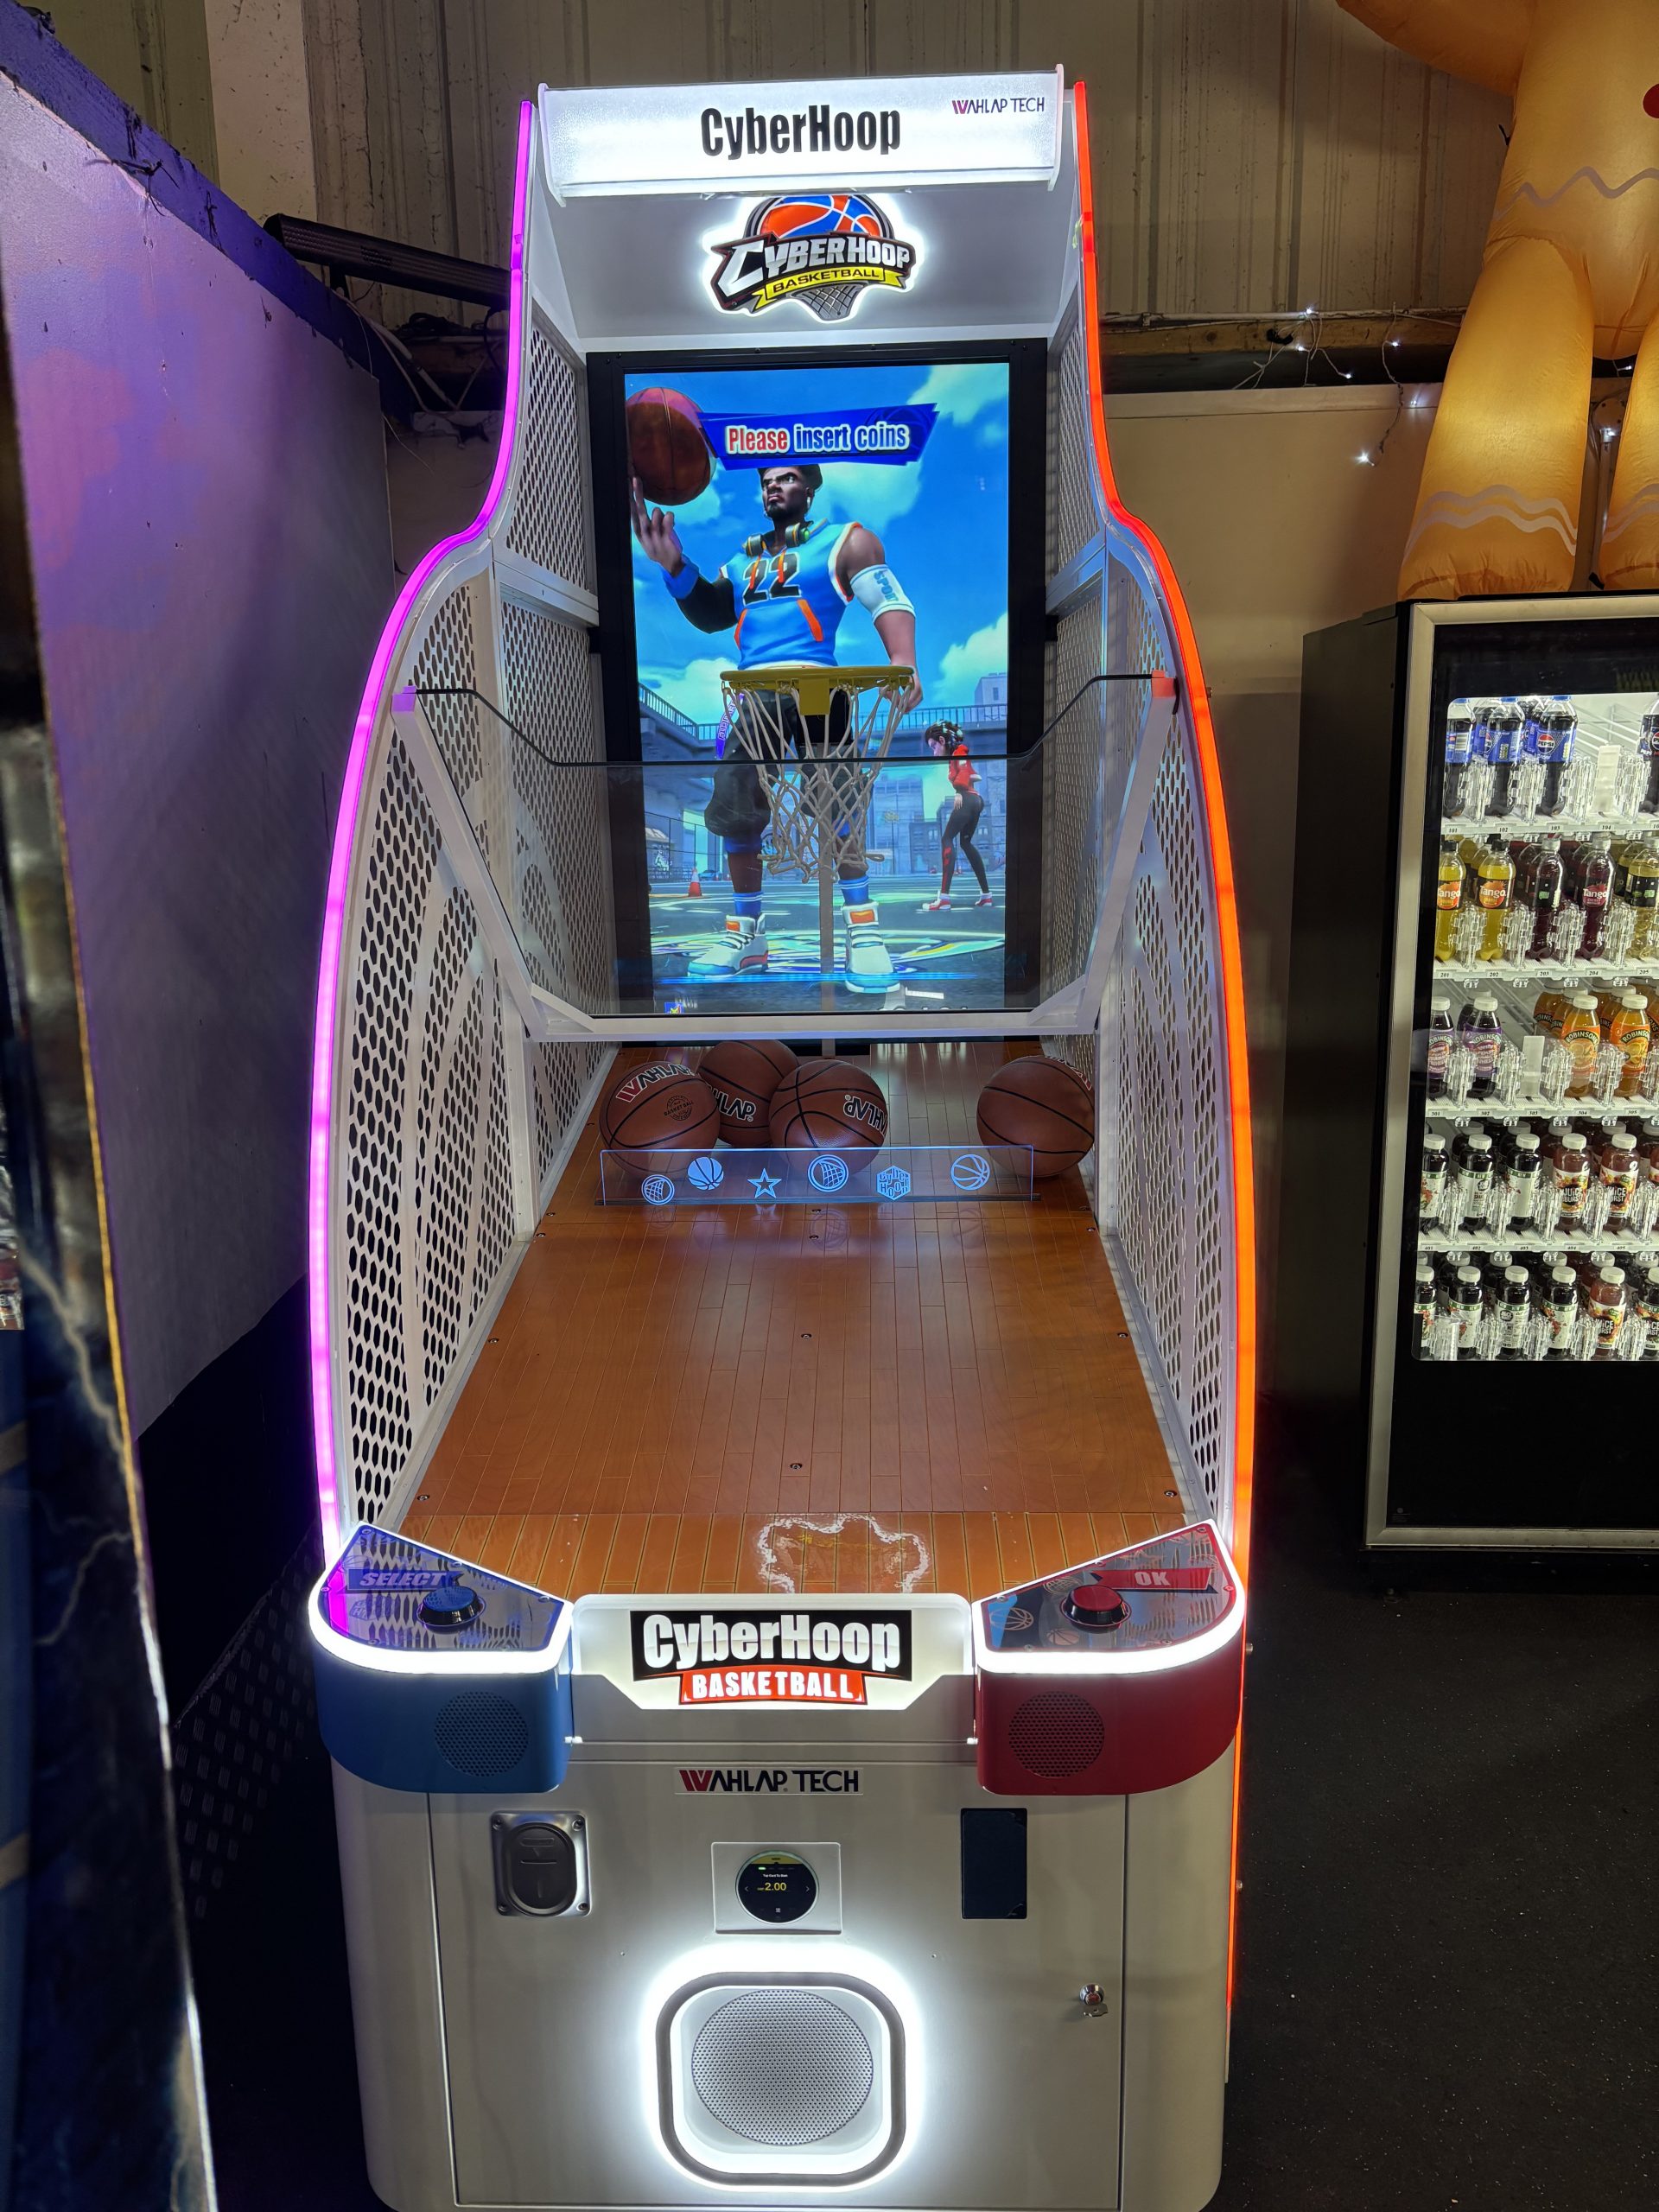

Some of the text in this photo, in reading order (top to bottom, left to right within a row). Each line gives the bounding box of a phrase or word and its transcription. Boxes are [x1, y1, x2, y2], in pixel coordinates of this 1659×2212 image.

[951, 97, 1045, 115] WAHLAP TECH
[701, 104, 900, 161] CyberHoop
[717, 235, 910, 297] CYBERHOOP
[772, 268, 880, 294] BASKETBALL
[728, 422, 908, 453] Please insert coins
[742, 551, 802, 607] 22
[712, 1086, 756, 1121] HLAP
[359, 1572, 447, 1587] SELECT
[1134, 1571, 1171, 1586] OK
[643, 1614, 900, 1672] CyberHoop
[691, 1670, 854, 1700] BASKETBALL
[678, 1769, 859, 1792] WAHLAP TECH
[764, 1882, 787, 1891] 2.00
